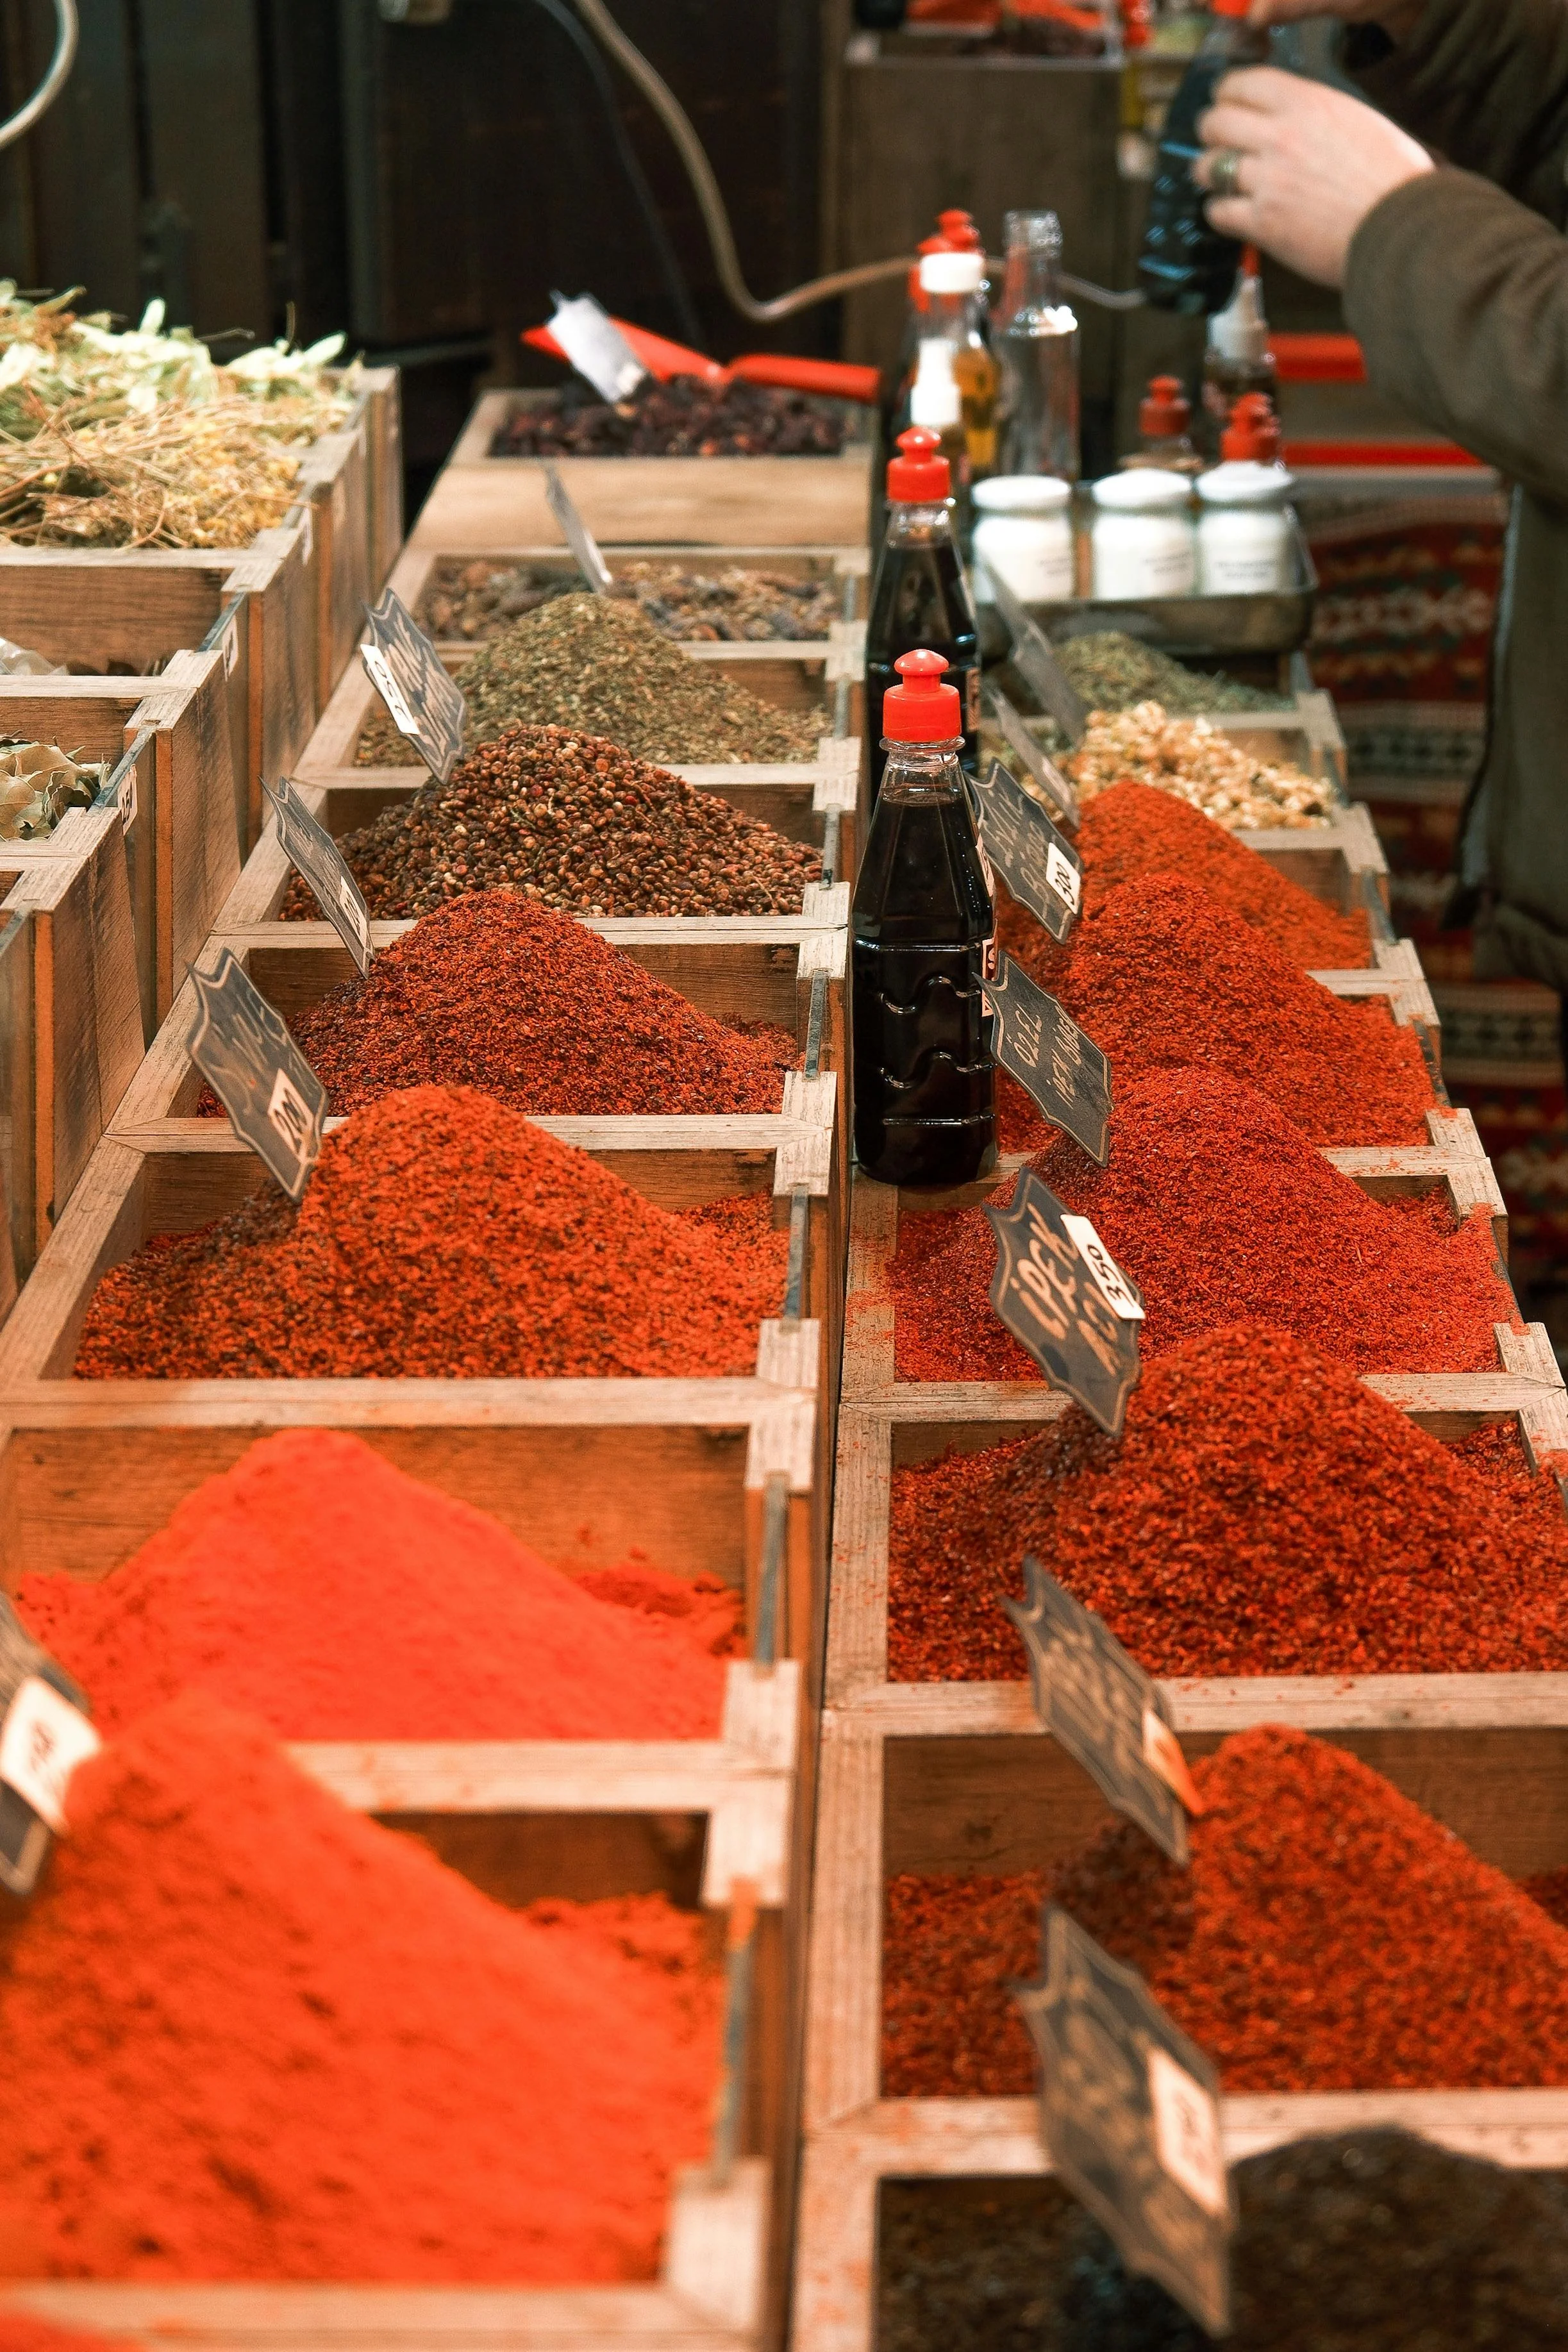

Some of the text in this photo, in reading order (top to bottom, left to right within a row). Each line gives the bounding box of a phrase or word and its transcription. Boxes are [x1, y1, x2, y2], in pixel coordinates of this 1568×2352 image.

[374, 660, 411, 723] 250
[1054, 861, 1075, 906] 300
[1006, 1003, 1042, 1068] ÖZEL
[1046, 1047, 1076, 1109] İPEK
[273, 1088, 308, 1153] 200
[1010, 1203, 1080, 1340] İPEK
[1086, 1243, 1135, 1308] 350
